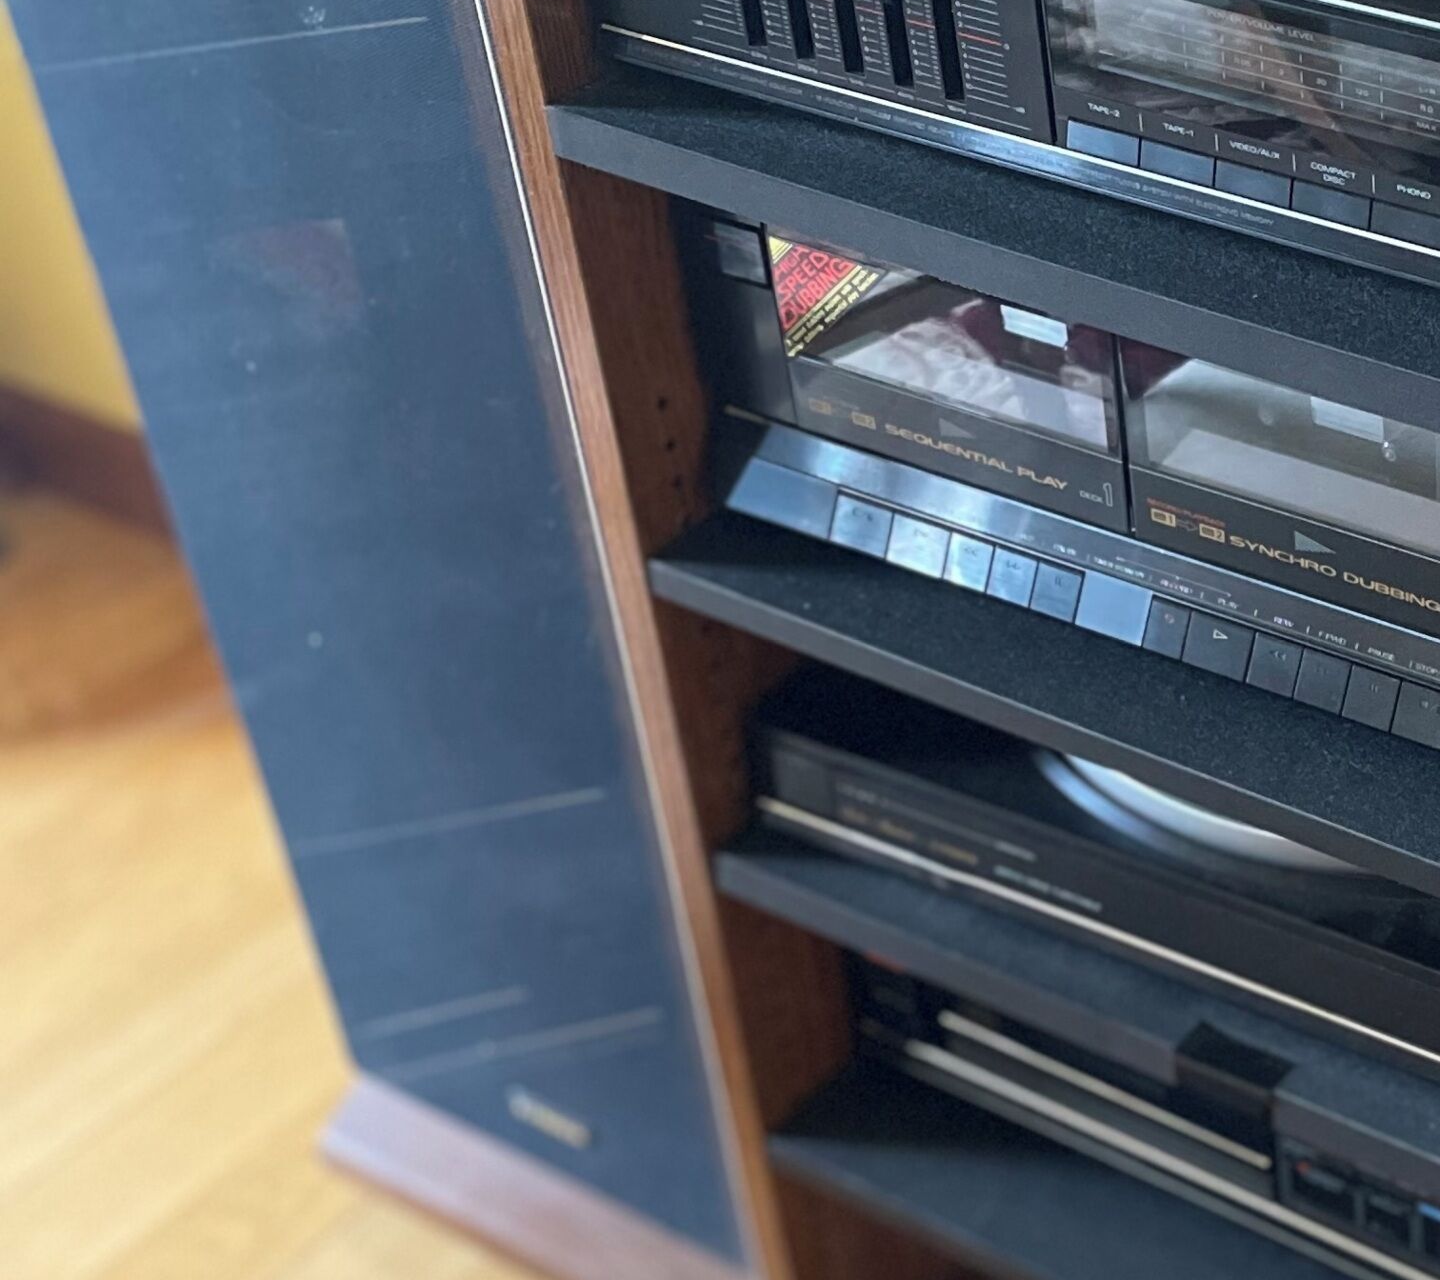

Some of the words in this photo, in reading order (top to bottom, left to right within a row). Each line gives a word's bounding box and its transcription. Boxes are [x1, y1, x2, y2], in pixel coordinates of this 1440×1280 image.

[1287, 28, 1316, 43] LEVEL
[1086, 102, 1121, 120] TAPE-2
[1162, 121, 1196, 138] TAPE-1
[1228, 139, 1282, 161] VIDEO/AUX
[1309, 160, 1357, 181] COMPACT
[1321, 173, 1347, 187] DISC
[1396, 182, 1432, 202] PHONO
[776, 251, 830, 302] SPEED
[779, 257, 856, 331] DUBBING
[884, 422, 1014, 474] SEQUENTIAL
[1016, 465, 1068, 491] PLAY
[1078, 489, 1104, 504] DECK
[1102, 482, 1114, 508] 1
[1228, 534, 1338, 579] SYNCHRO
